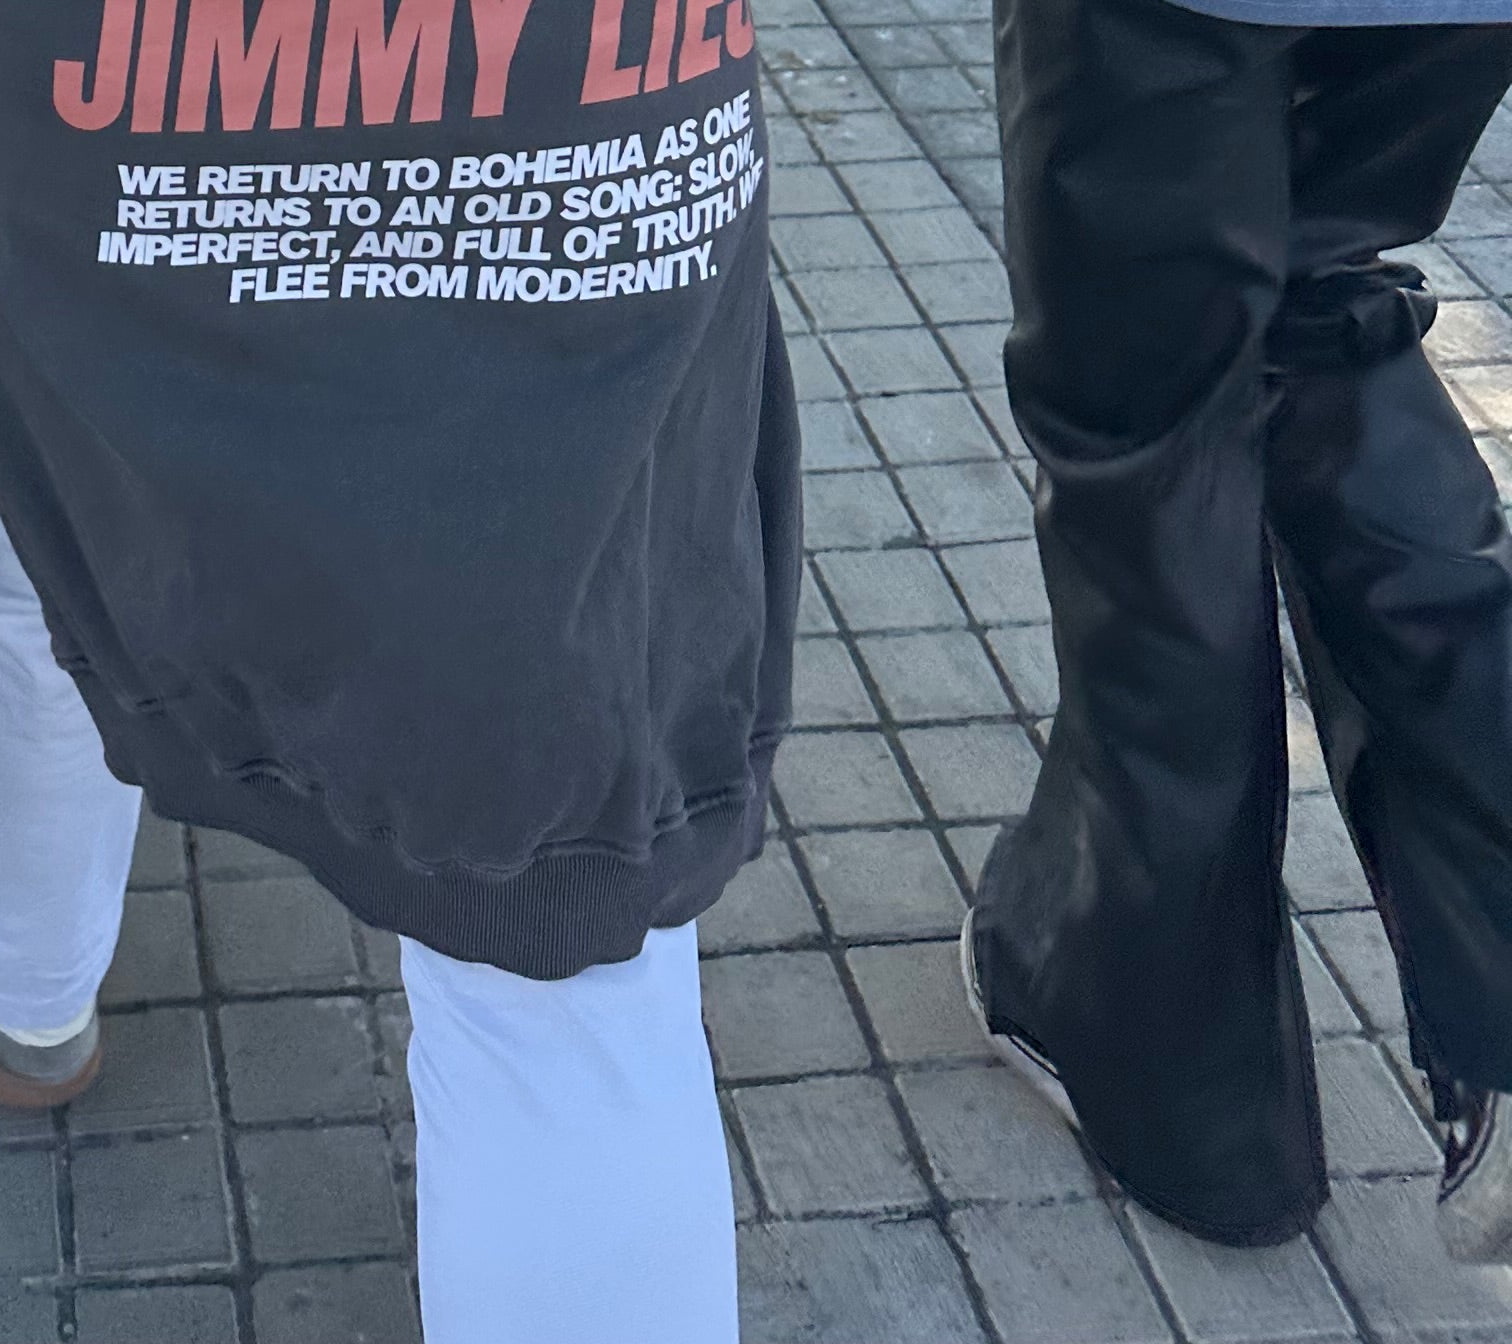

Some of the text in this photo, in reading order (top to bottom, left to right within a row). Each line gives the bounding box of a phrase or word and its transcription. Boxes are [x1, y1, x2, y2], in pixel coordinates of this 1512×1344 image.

[117, 89, 750, 195] WE RETURN TO BOHEMIA AS ONE
[117, 128, 754, 229] RETURNS TO AN OLD SONG: SLOW,
[98, 230, 341, 266] IMPERFECT,
[349, 230, 443, 258] AND
[453, 226, 552, 261] FULL
[563, 221, 622, 262] OF
[633, 184, 737, 253] TRUTH.
[229, 240, 718, 303] FLEE FROM MODERNITY.
